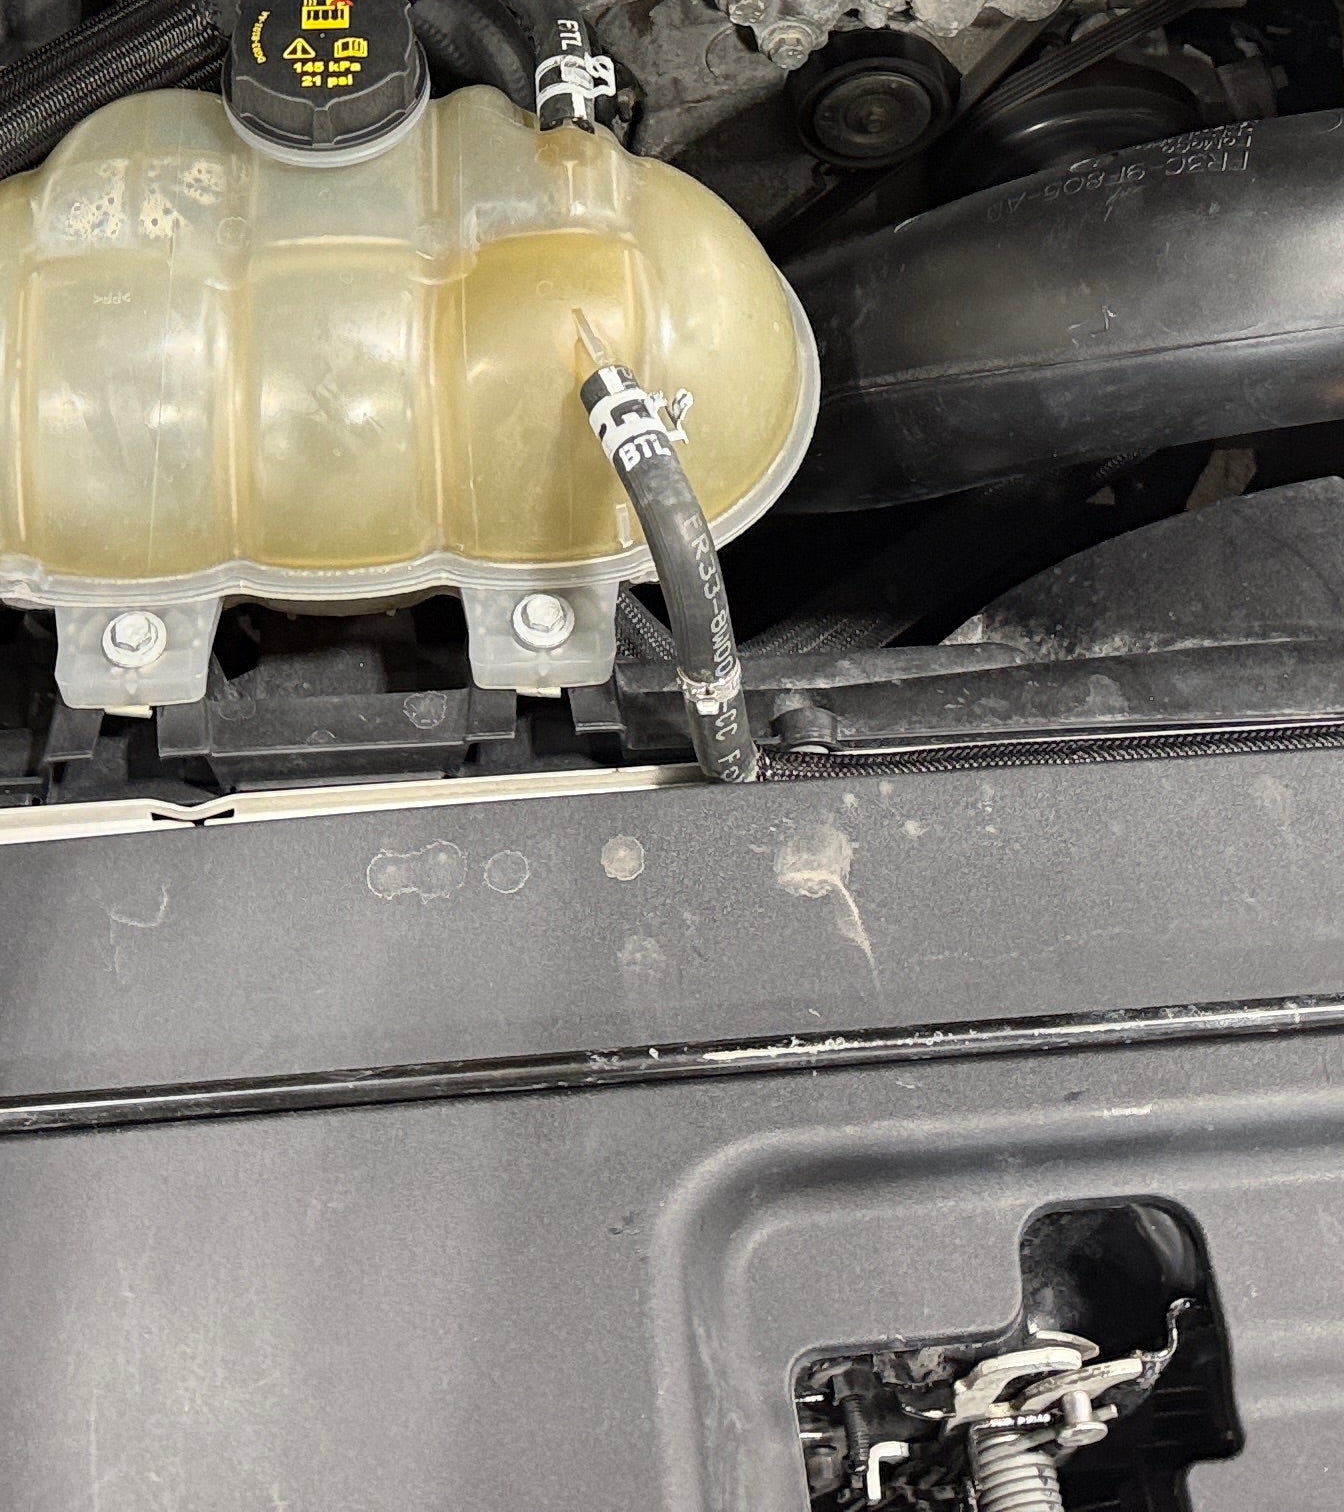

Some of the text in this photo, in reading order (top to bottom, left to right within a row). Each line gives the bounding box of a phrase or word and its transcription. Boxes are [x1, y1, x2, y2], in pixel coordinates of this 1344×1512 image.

[293, 61, 362, 74] 145 kPa
[301, 75, 354, 89] 21 psi
[618, 433, 671, 473] BTL
